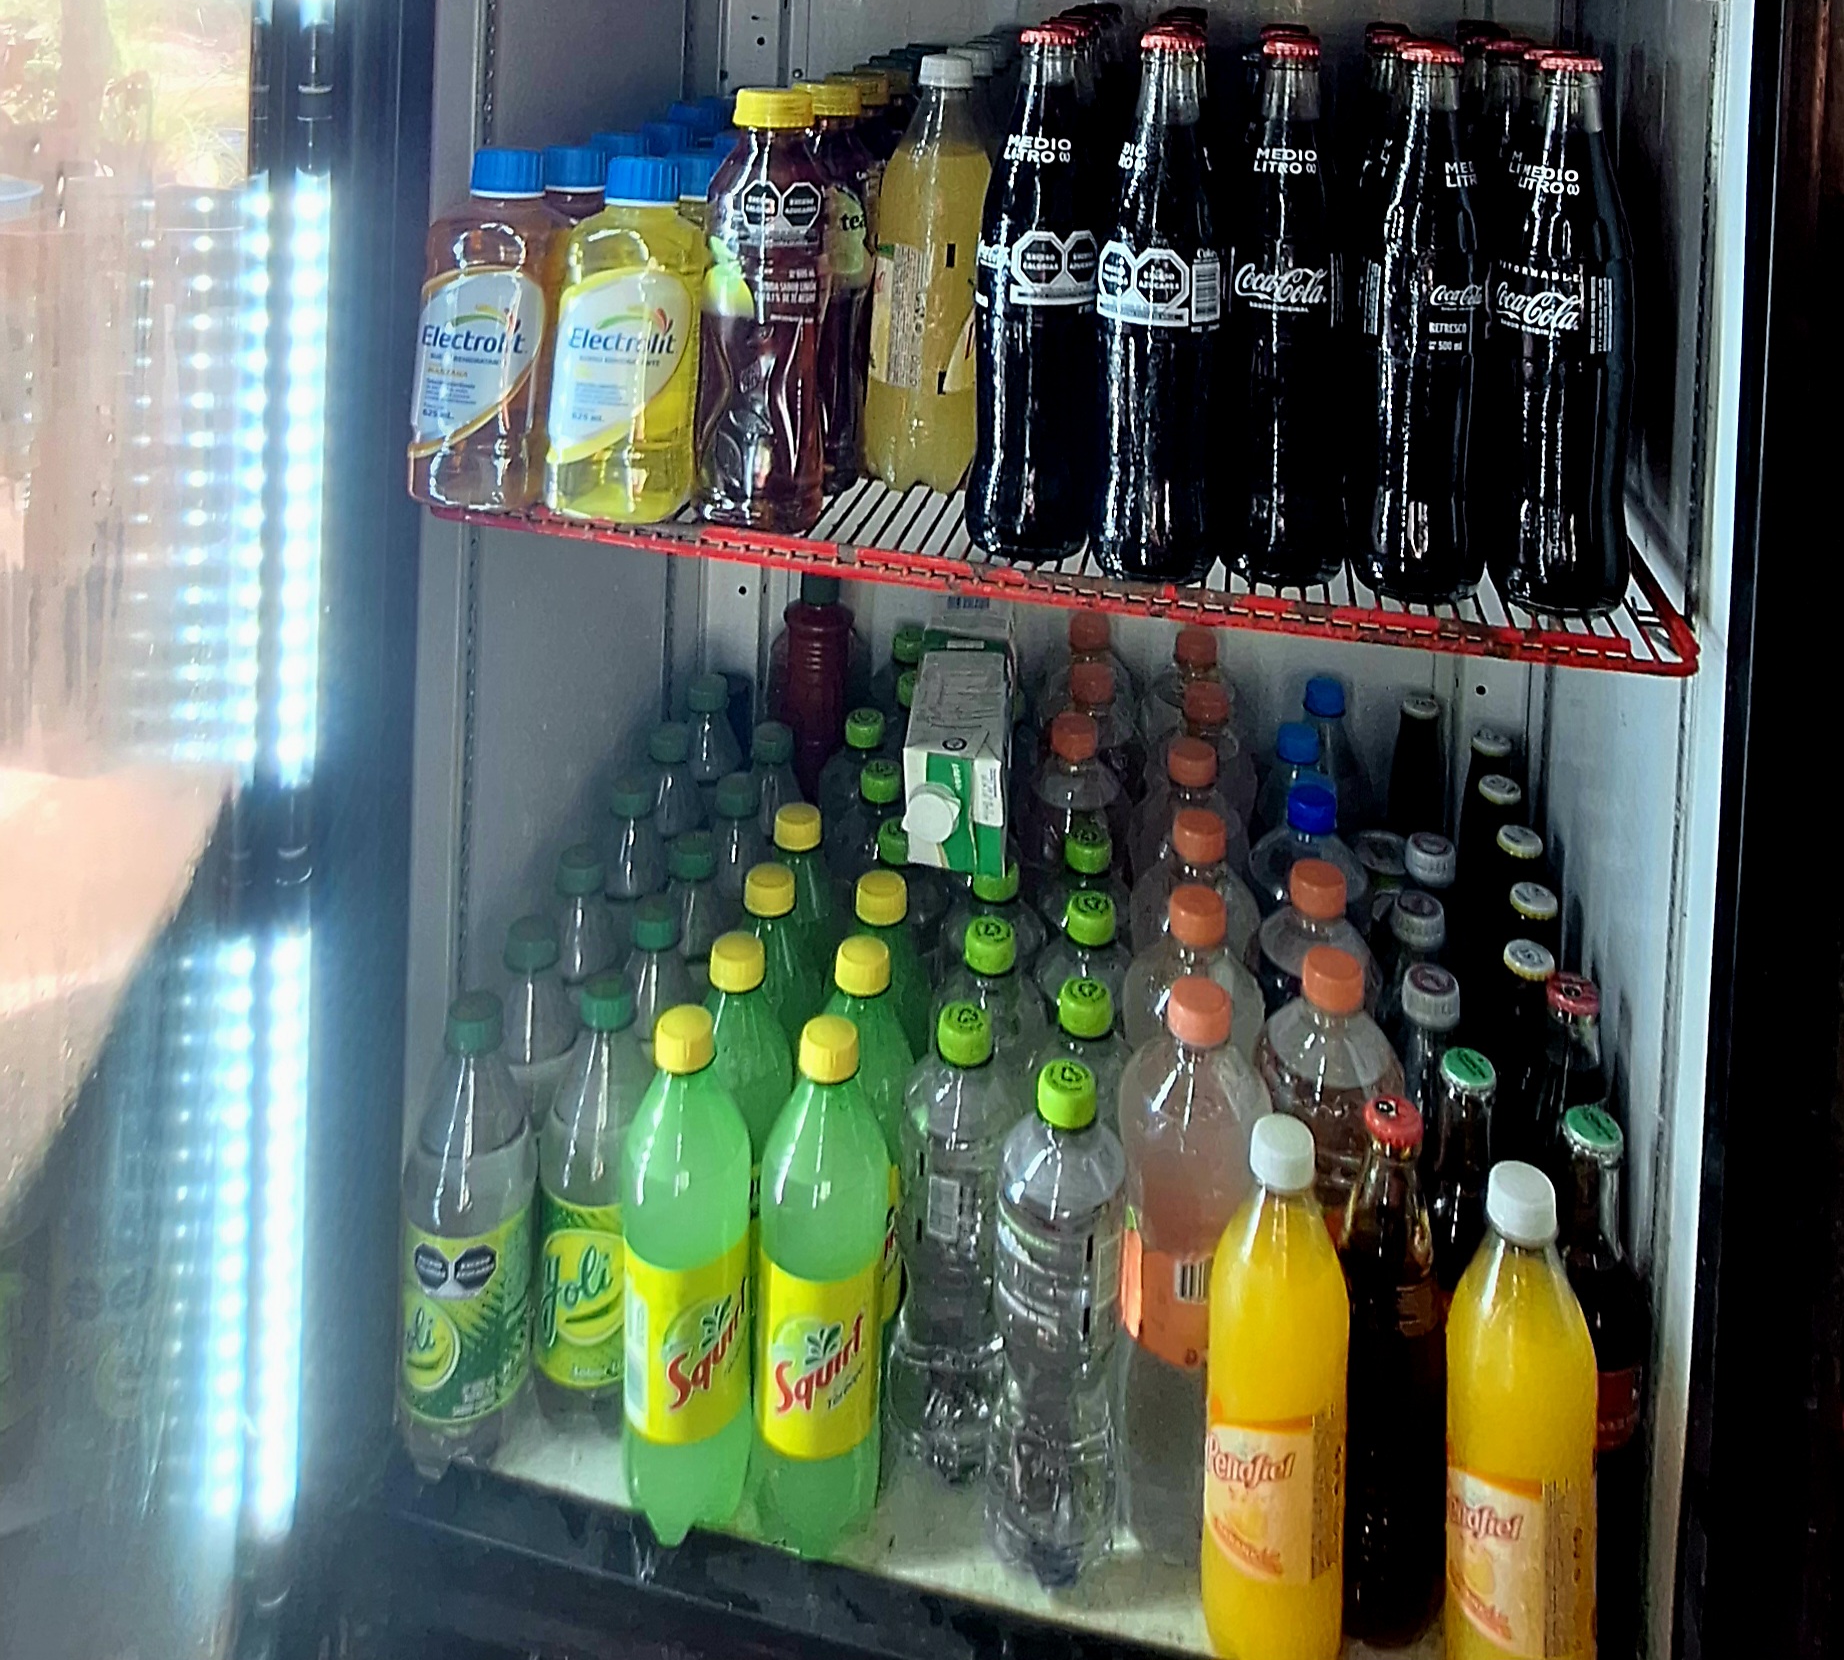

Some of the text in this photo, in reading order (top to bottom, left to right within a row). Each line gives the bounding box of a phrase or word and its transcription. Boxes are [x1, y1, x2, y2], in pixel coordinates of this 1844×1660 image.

[1006, 133, 1072, 152] MEDIO
[1003, 145, 1056, 164] LITRO
[1255, 147, 1318, 163] MEDIO
[1252, 159, 1303, 176] LITRO
[1522, 165, 1579, 182] MEDIO
[1445, 173, 1478, 188] LITR
[1518, 176, 1565, 195] LITRO
[1025, 252, 1056, 262] EXCESO
[1234, 262, 1329, 305] Coca-Cola
[1428, 322, 1467, 334] REFRESCO
[421, 323, 527, 355] Electrolt
[775, 1310, 866, 1415] Squirt
